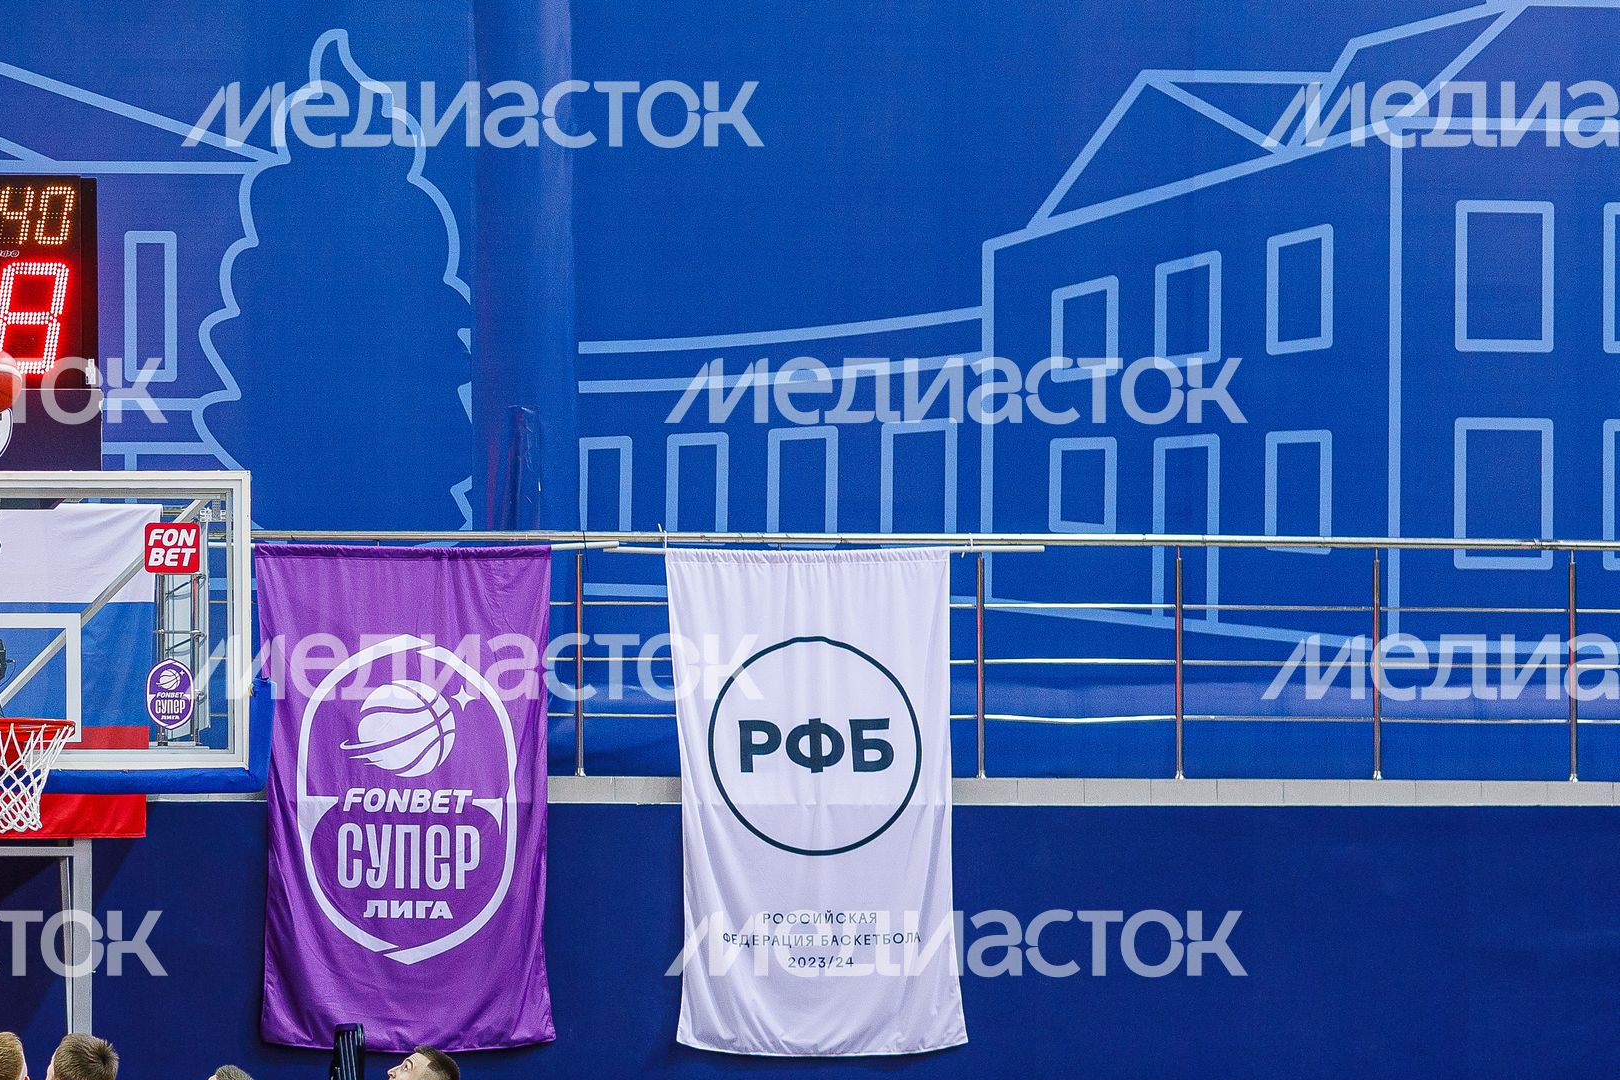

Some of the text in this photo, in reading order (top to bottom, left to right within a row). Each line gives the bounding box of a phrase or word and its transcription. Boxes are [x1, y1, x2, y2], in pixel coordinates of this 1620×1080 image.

[148, 528, 196, 546] FON
[148, 548, 196, 567] BET
[737, 717, 895, 773] РФБ
[343, 787, 473, 814] FONBET
[337, 822, 481, 891] СУПЕР
[363, 899, 453, 920] ЛИГА
[762, 910, 877, 925] РОССИЙСКАЯ
[722, 932, 921, 948] ФЕДЕРАЦИЯ БАСКЕТБОЛА
[787, 956, 854, 969] 2023/24
